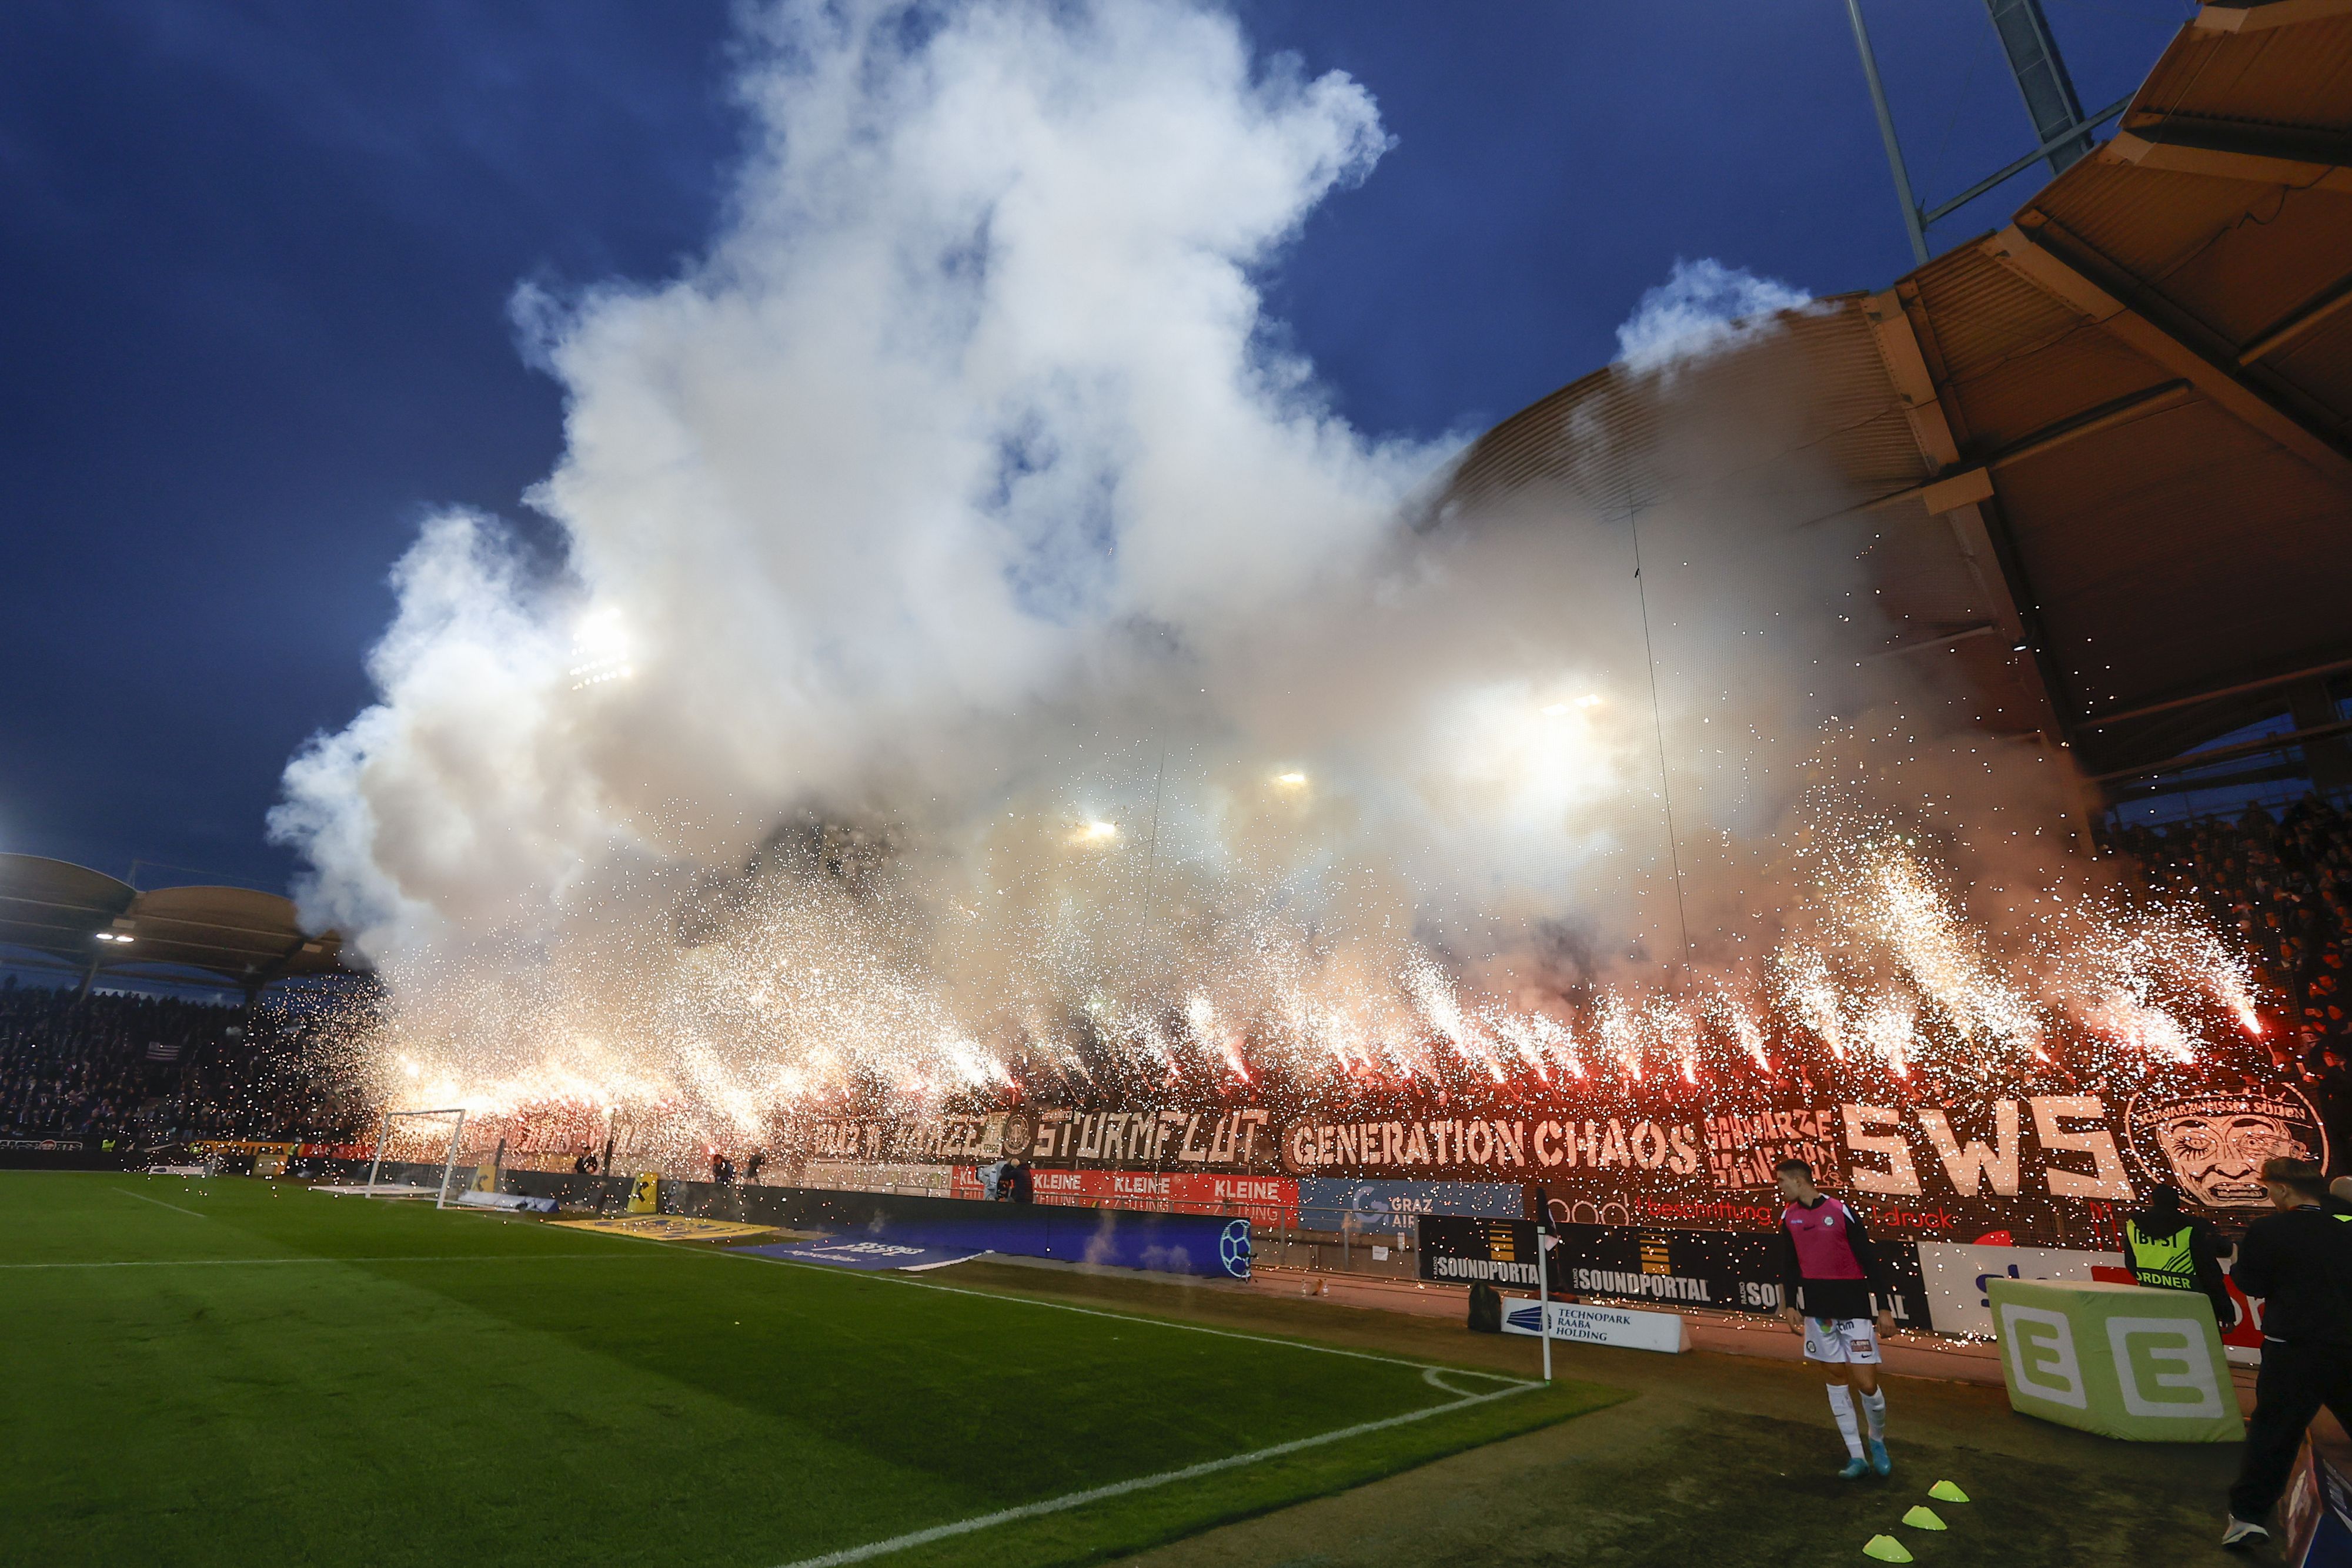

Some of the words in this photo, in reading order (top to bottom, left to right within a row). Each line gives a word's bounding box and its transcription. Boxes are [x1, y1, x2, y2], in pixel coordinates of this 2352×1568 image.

[1033, 1109, 1270, 1162] STURMFLUT
[1293, 1118, 1526, 1167] GENERATION
[1534, 1118, 1698, 1175] CHAOS
[1842, 1096, 2136, 1200] SWS
[1034, 1174, 1081, 1190] KLEINE
[1114, 1176, 1170, 1194] KLEINE
[1215, 1180, 1279, 1200] KLEINE
[1391, 1197, 1432, 1215] GRAZ
[1648, 1196, 1771, 1226] beschriftung
[1885, 1206, 1953, 1229] druck
[1438, 1256, 1541, 1285] SOUNDPORTA
[1579, 1268, 1711, 1302] SOUNDPORTAL
[1558, 1318, 1591, 1329] RAABA
[1559, 1308, 1631, 1325] TECHNOPARK
[1556, 1327, 1608, 1342] HOLDING
